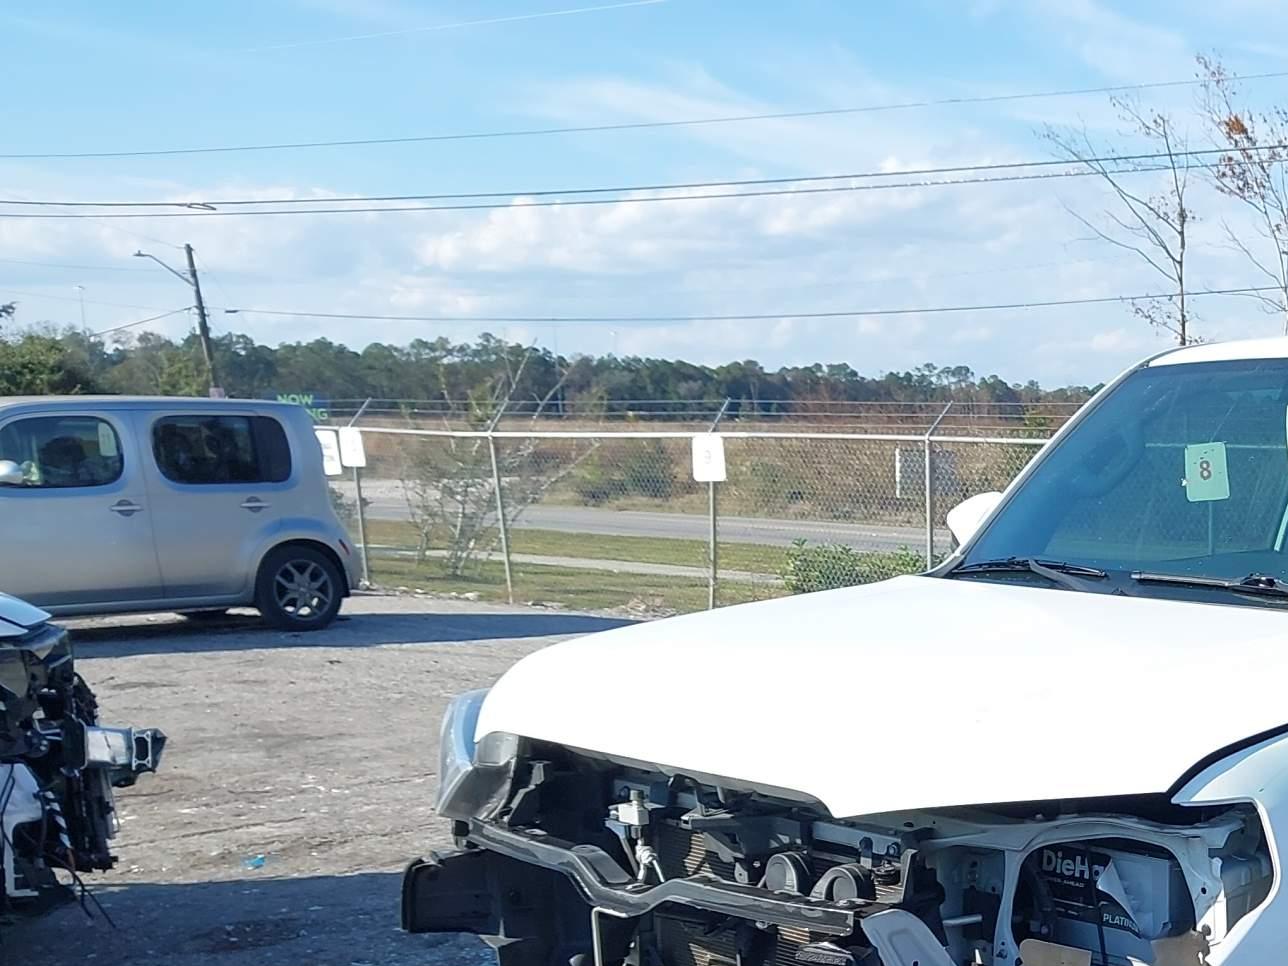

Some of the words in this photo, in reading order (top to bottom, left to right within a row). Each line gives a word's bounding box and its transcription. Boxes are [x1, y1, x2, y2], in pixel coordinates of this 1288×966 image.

[1200, 460, 1212, 480] 8
[1042, 849, 1104, 881] DieHa
[1103, 913, 1139, 933] PLATI
